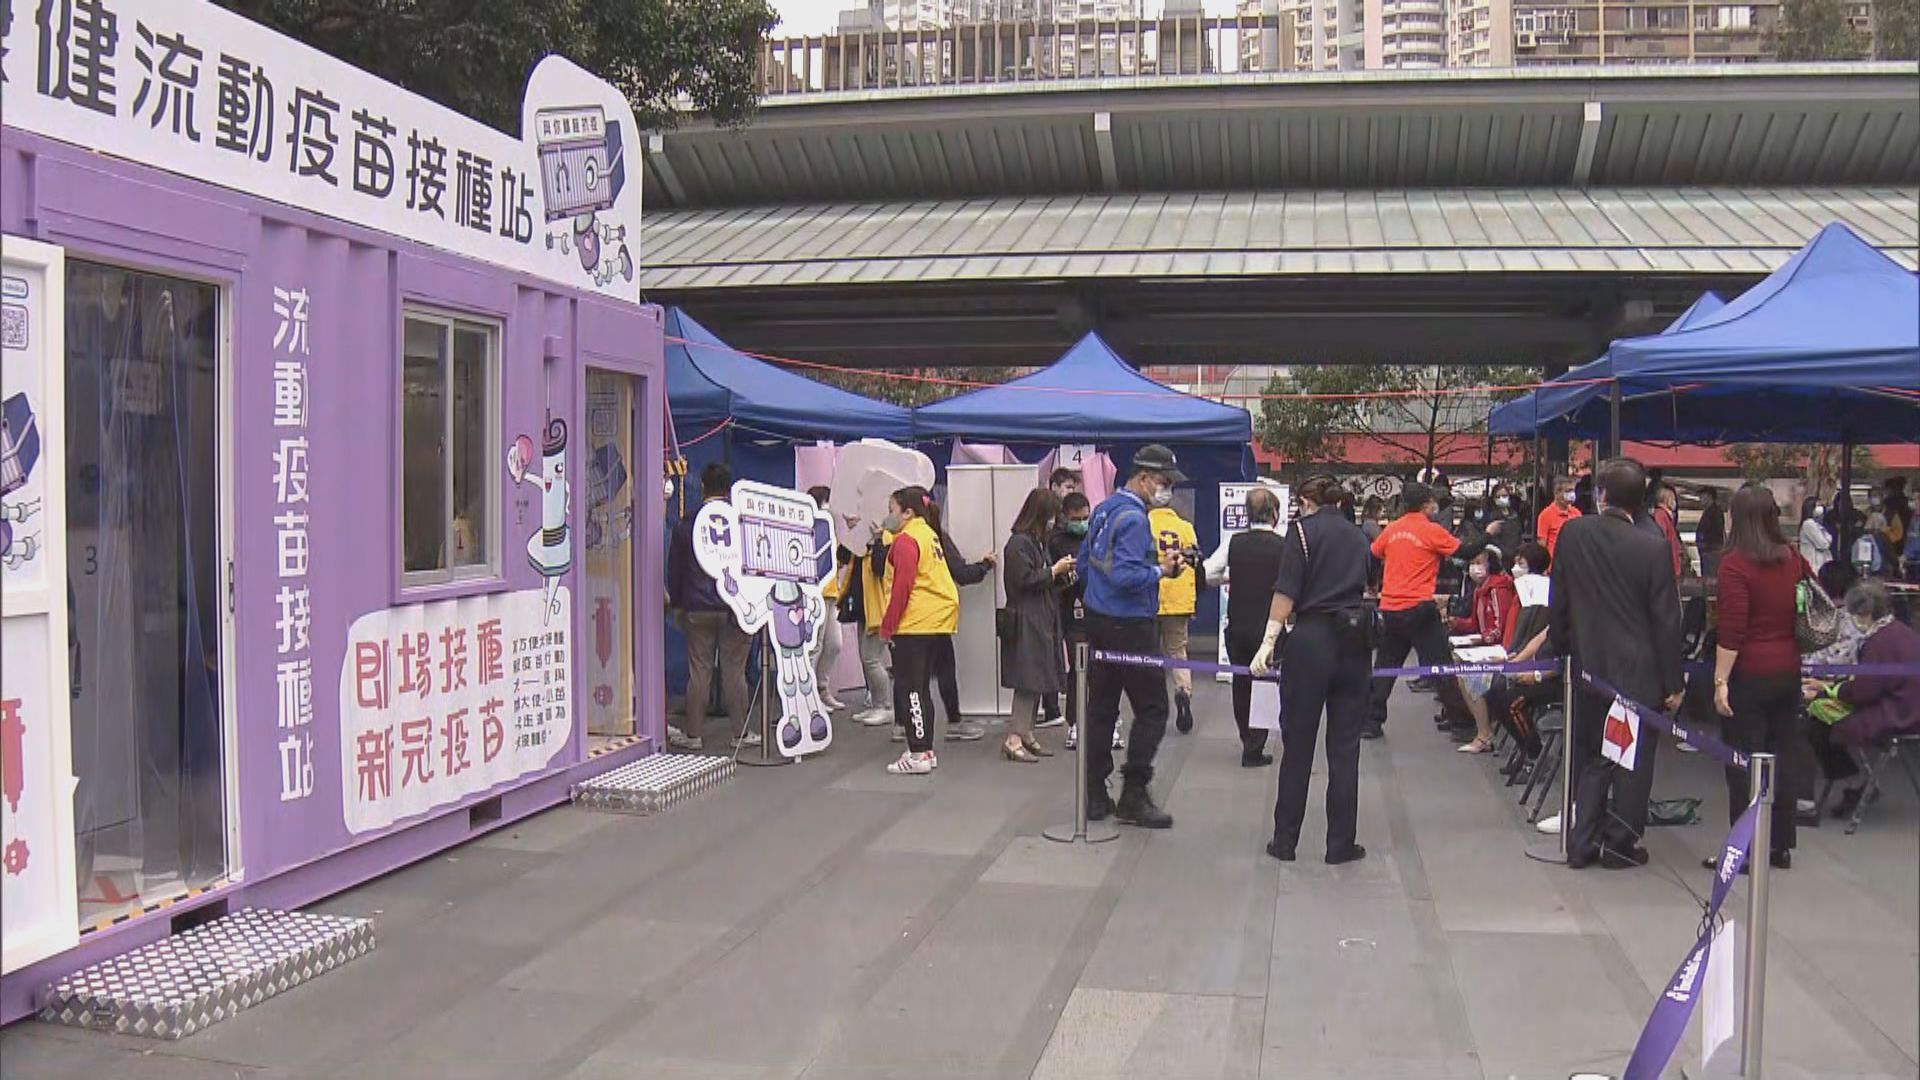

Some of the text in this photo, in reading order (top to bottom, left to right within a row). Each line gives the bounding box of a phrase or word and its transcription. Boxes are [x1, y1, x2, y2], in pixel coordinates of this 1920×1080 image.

[1, 0, 535, 244] 健流動疫苗接種站
[1072, 449, 1083, 464] 4
[85, 544, 97, 575] 3
[272, 285, 314, 802] 流動疫苗接種站
[355, 618, 504, 711] 即場接種
[1123, 653, 1143, 663] Health
[1442, 665, 1460, 674] Town
[1460, 663, 1482, 673] Health
[909, 691, 925, 739] adidas
[356, 696, 505, 803] 新冠疫苗
